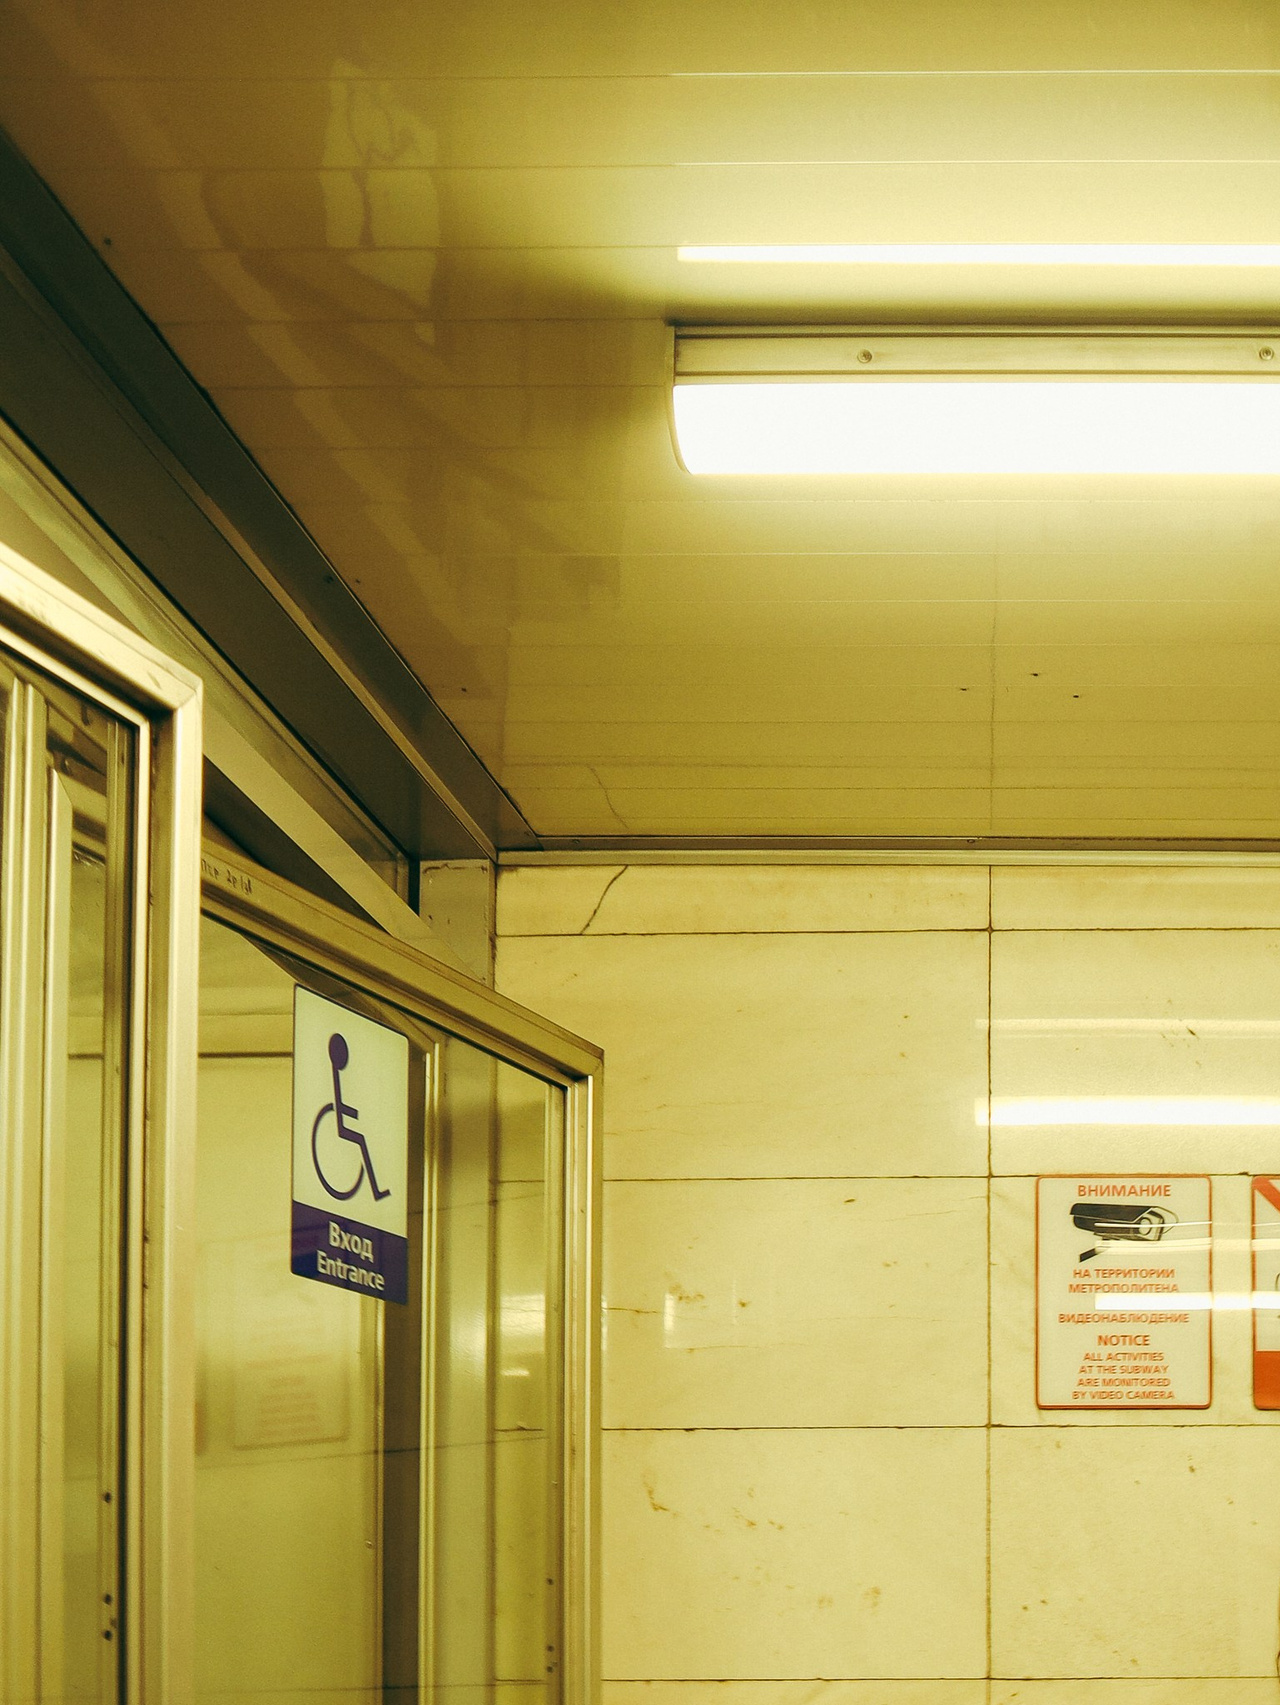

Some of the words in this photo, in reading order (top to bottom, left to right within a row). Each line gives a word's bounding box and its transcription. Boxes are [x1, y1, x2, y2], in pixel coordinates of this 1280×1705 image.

[1077, 1184, 1172, 1198] ВНИМАНИЕ
[328, 1220, 375, 1263] Вход
[316, 1249, 385, 1291] Entrance
[1073, 1268, 1092, 1279] НА
[1094, 1268, 1176, 1279] ТЕРРИТОРИИ
[1068, 1283, 1179, 1294] МЕТРОПОЛИТЕНА
[1058, 1313, 1190, 1325] ВИДЕОНАБЛЮДЕНИЕ
[1097, 1334, 1151, 1347] NOTICE
[1083, 1352, 1104, 1362] ALL
[1106, 1352, 1165, 1362] ACTIVITIES
[1078, 1365, 1094, 1375] AT
[1096, 1365, 1117, 1375] THE
[1120, 1365, 1170, 1375] SUBWAY
[1077, 1378, 1100, 1388] ARE
[1102, 1378, 1171, 1388] MONITORED
[1072, 1391, 1087, 1400] BY
[1089, 1391, 1124, 1400] VIDEO
[1125, 1391, 1176, 1400] CAMERA
